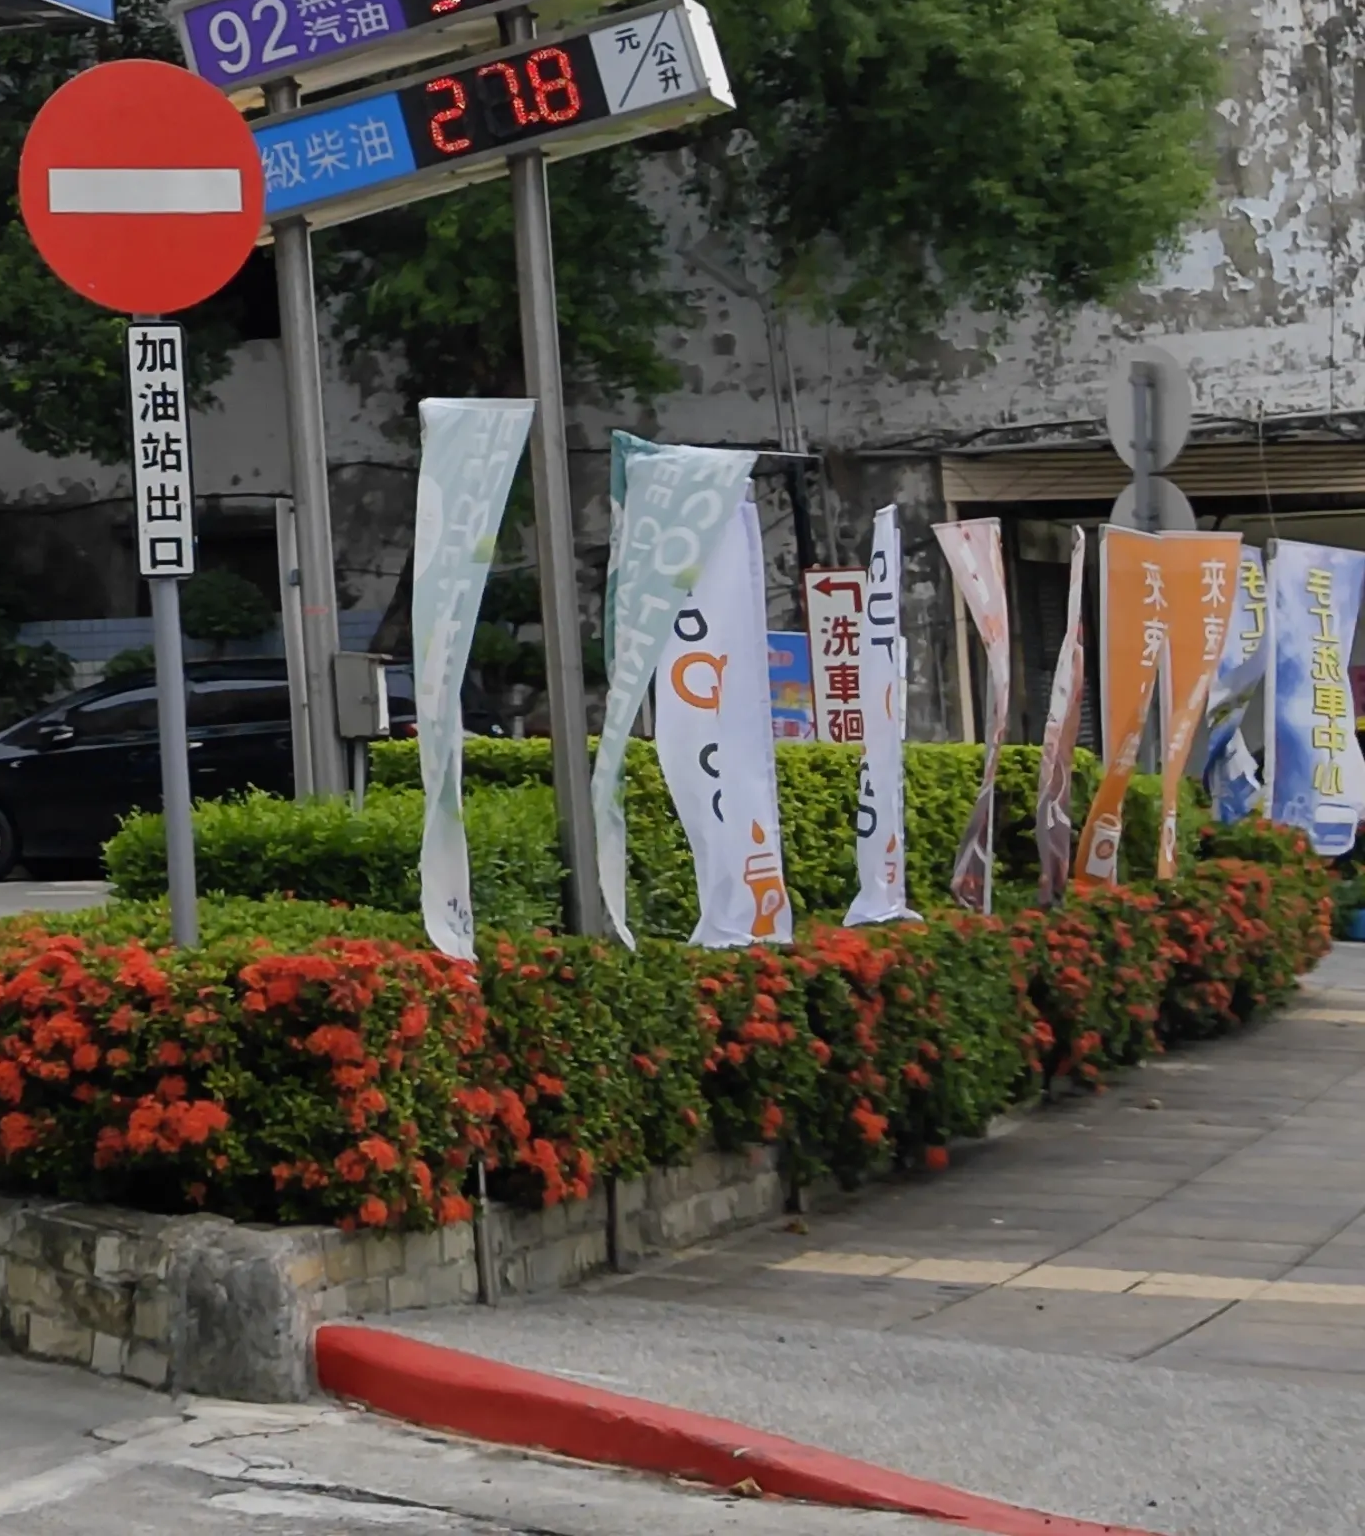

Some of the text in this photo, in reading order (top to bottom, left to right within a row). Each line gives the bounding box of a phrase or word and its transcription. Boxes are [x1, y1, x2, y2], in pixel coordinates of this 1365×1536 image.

[303, 3, 390, 51] 汽油
[426, 48, 581, 154] 27.8
[135, 331, 184, 569] 加油站出口
